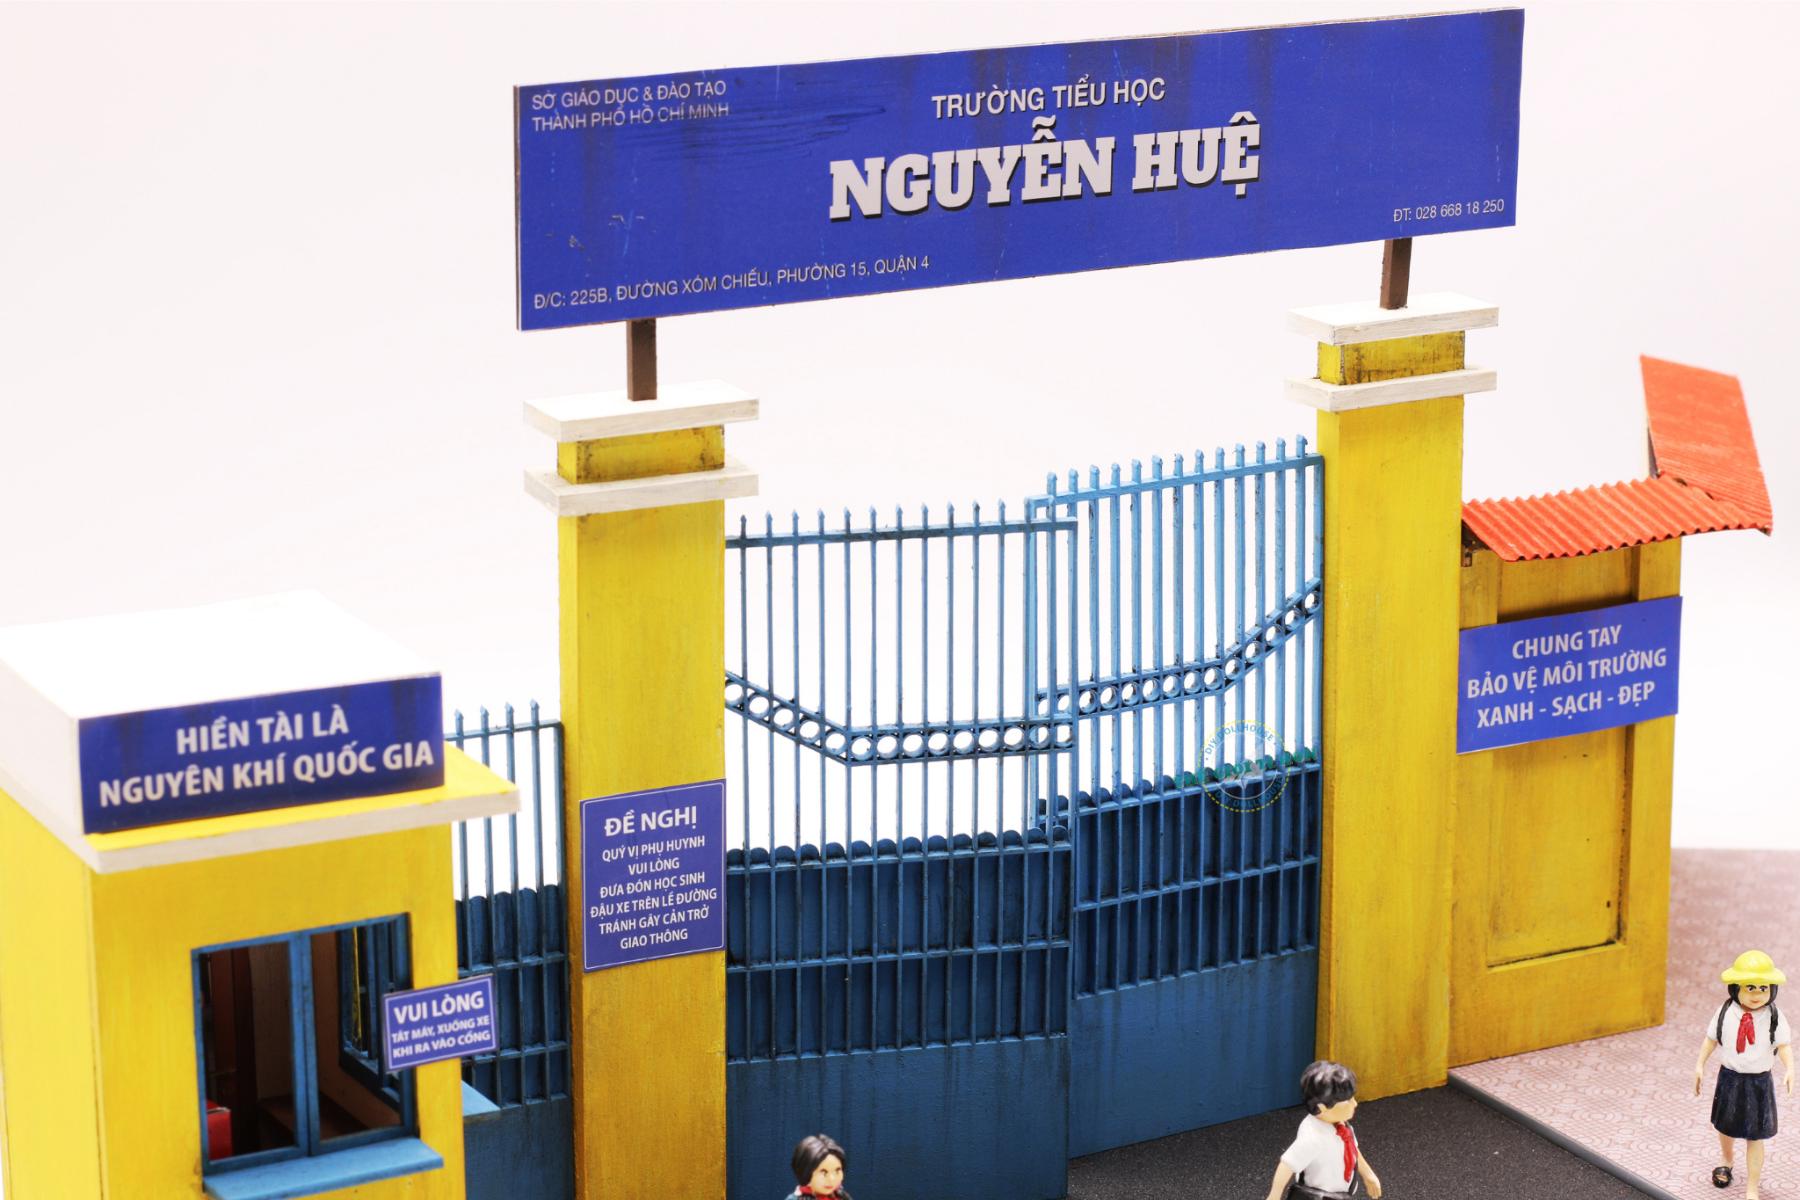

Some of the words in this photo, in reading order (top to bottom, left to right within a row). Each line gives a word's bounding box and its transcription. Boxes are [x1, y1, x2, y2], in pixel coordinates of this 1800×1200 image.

[532, 89, 556, 110] SỞ
[562, 87, 601, 107] GIÁO
[605, 86, 639, 107] DỤC
[643, 87, 653, 100] &
[657, 81, 691, 99] ĐÀO
[695, 80, 726, 98] TẠO
[932, 88, 1044, 119] TRƯỜNG
[1053, 75, 1105, 109] TIỂU
[1114, 78, 1165, 107] HỌC
[533, 111, 586, 131] THÀNH
[630, 104, 653, 124] HỒ
[658, 103, 685, 122] CHÍ
[689, 103, 729, 120] MINH
[830, 115, 1115, 220] NGUYỄN
[1132, 111, 1260, 197] HUỆ
[1394, 208, 1411, 222] ĐT:
[1416, 206, 1437, 219] 028
[1440, 203, 1462, 217] 668
[1467, 201, 1479, 214] 18
[1483, 199, 1504, 213] 250
[534, 290, 566, 309] Đ/C:
[616, 277, 677, 301] ĐƯỜNG
[682, 273, 717, 293] XÓM
[721, 267, 772, 289] CHIẾU,
[778, 261, 846, 285] PHƯỜNG
[875, 253, 916, 274] QUẬN
[921, 256, 929, 270] 4
[1512, 632, 1583, 659] CHUNG
[1588, 625, 1622, 648] TAY
[1467, 671, 1507, 698] BẢO
[1512, 666, 1537, 694] VỆ
[1543, 661, 1583, 687] MÔI
[1588, 648, 1667, 679] TRƯỜNG
[1477, 702, 1533, 728] XANH
[1552, 691, 1602, 720] SẠCH
[1618, 681, 1655, 707] ĐẸP
[257, 710, 303, 744] TÀI
[313, 704, 349, 736] LÀ
[100, 764, 224, 807] NGUYÊN
[233, 753, 285, 789] KHÍ
[294, 741, 376, 783] QUỐC
[383, 741, 434, 770] GIA
[604, 810, 635, 837] ĐỀ
[641, 806, 697, 831] NGHỊ
[628, 845, 639, 860] VỊ
[642, 842, 664, 857] PHỤ
[666, 836, 705, 852] HUYNH
[628, 862, 647, 875] VUI
[650, 858, 680, 873] LÒNG
[600, 884, 624, 898] ĐƯA
[626, 879, 651, 894] ĐÓN
[654, 877, 677, 892] HỌC
[680, 872, 705, 886] SINH
[590, 901, 614, 920] ĐẬU
[617, 902, 630, 913] XE
[633, 896, 659, 912] TRÊN
[676, 888, 717, 903] ĐƯỜNG
[599, 918, 636, 934] TRÁNH
[639, 914, 660, 928] GÂY
[663, 908, 685, 925] CẢN
[688, 904, 710, 920] TRỞ
[620, 934, 647, 949] GIAO
[650, 928, 688, 944] THÔNG
[394, 1002, 428, 1024] VUI
[432, 991, 484, 1017] LÒNG
[477, 1015, 490, 1026] XE
[393, 1045, 413, 1058] KHI
[415, 1042, 430, 1053] RA
[431, 1037, 456, 1050] VÀO
